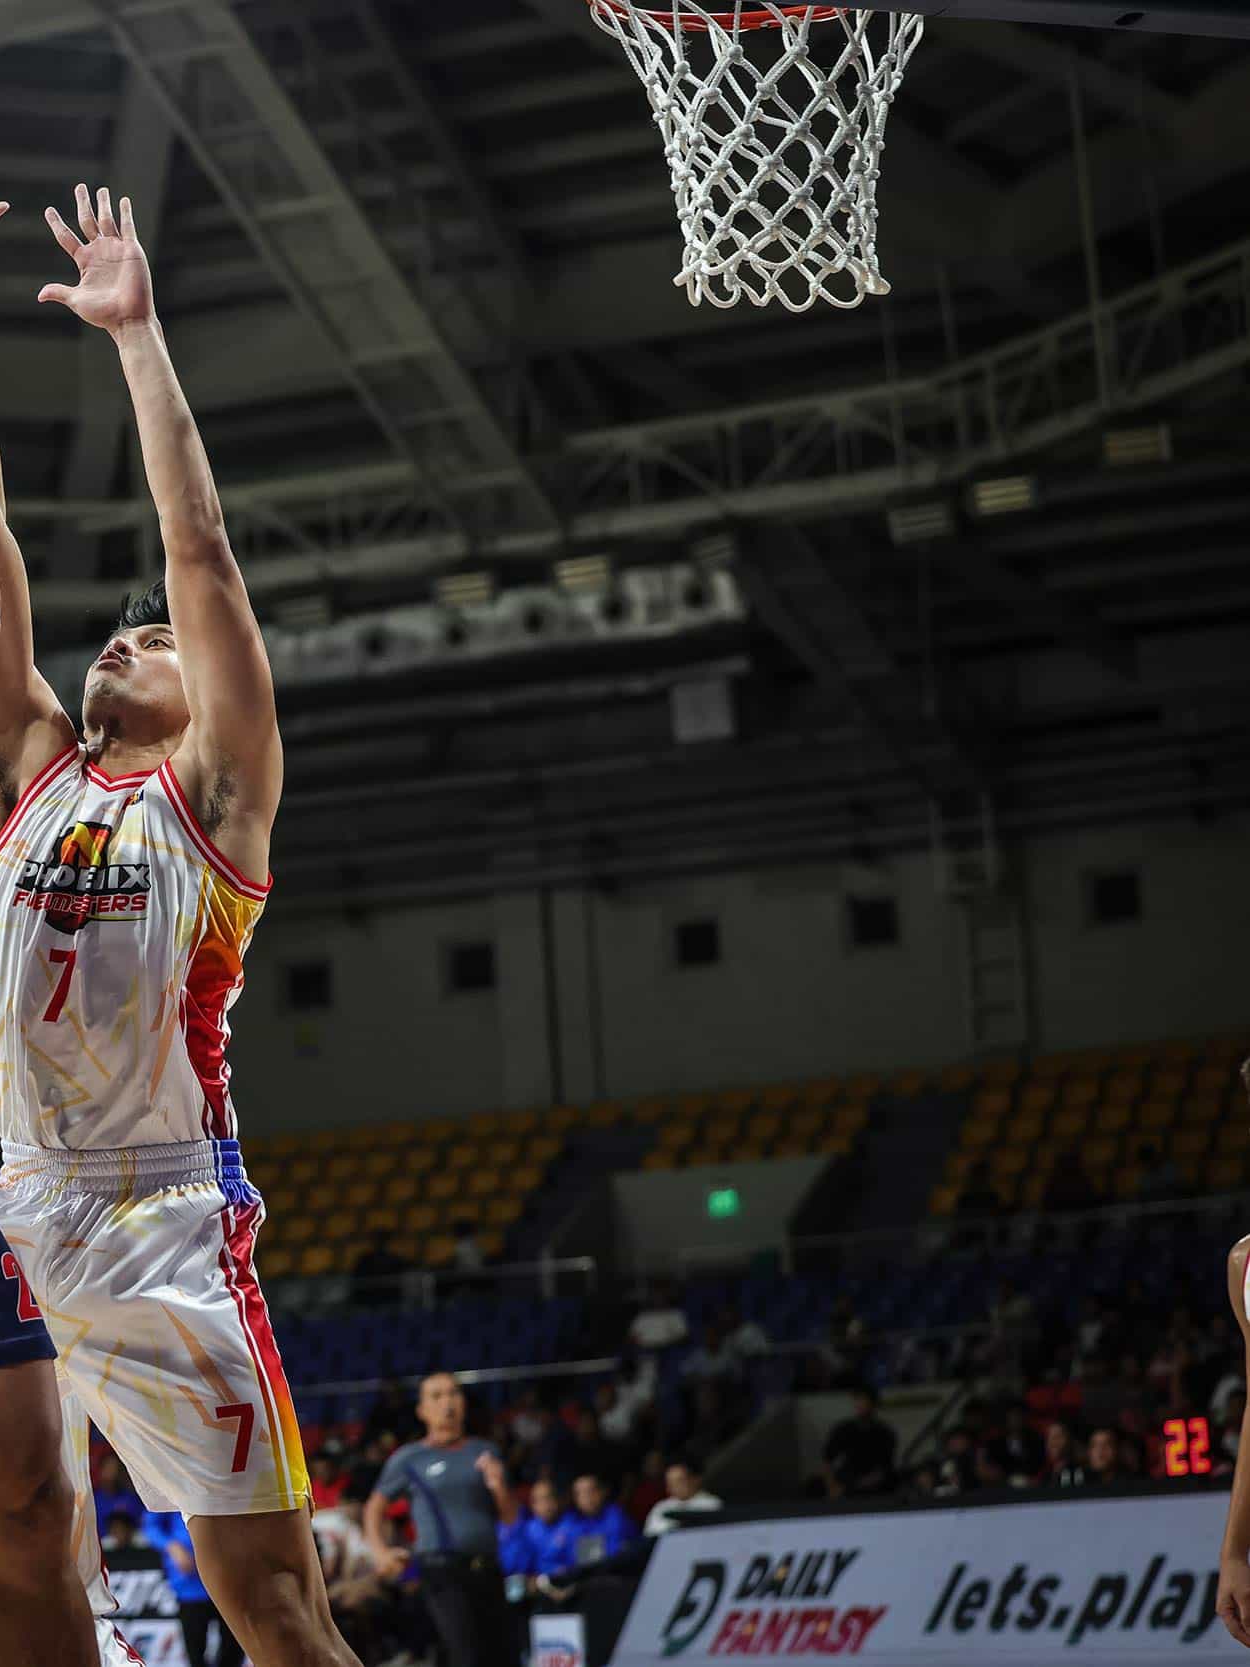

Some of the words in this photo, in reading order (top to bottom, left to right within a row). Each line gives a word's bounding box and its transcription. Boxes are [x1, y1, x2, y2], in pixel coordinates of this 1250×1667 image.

[42, 947, 78, 1023] 7
[215, 1402, 254, 1473] 7
[1163, 1417, 1211, 1476] 22
[735, 1548, 861, 1600] DAILY
[707, 1604, 888, 1656] FANTASY
